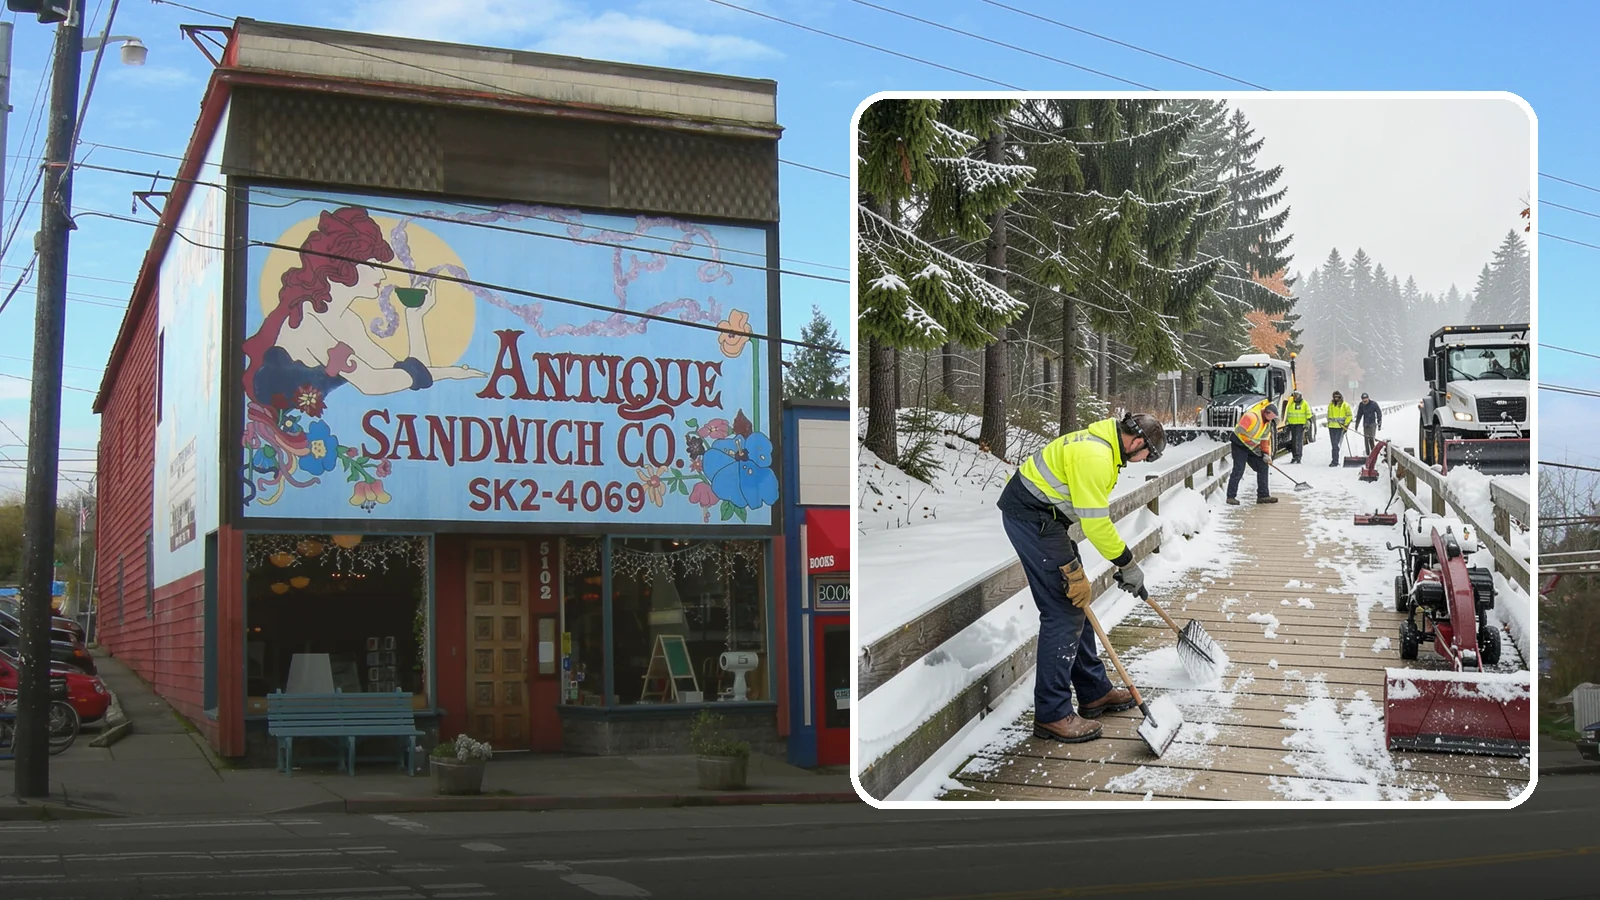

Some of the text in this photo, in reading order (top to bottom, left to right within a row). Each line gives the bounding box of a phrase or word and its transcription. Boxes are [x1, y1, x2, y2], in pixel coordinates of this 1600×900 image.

[476, 329, 723, 421] ANTIQUE
[361, 408, 686, 470] SANDWICH CO.
[468, 477, 646, 513] SK2-4069
[540, 541, 552, 600] 5102
[809, 555, 835, 569] BOOKS
